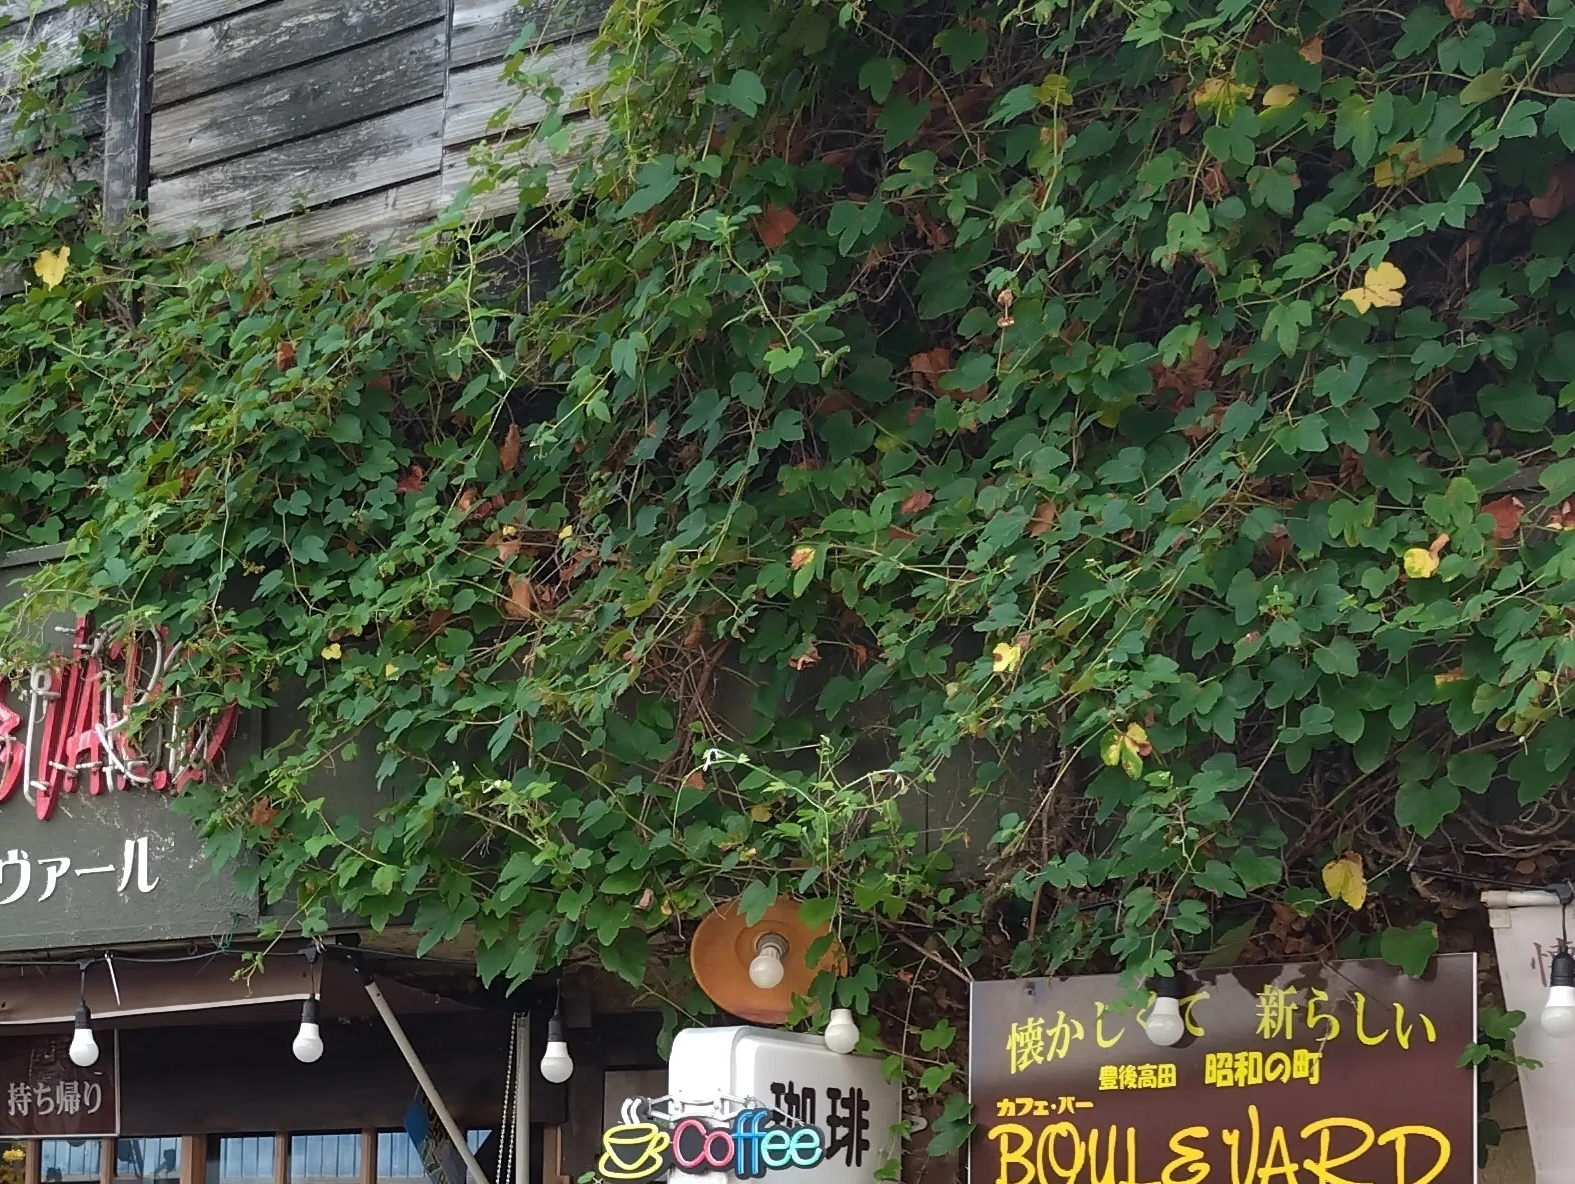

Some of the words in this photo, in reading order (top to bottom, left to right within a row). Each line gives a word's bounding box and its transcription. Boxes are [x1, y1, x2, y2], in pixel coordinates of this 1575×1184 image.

[1256, 984, 1437, 1050] 新らしい
[1098, 1064, 1177, 1092] 豊後高田
[1204, 1049, 1322, 1087] 昭和の町
[7, 1080, 101, 1116] 持ち帰り
[770, 1081, 870, 1167] 珈琲
[996, 1097, 1093, 1118] カフェ・バー
[672, 1109, 823, 1176] Coffee
